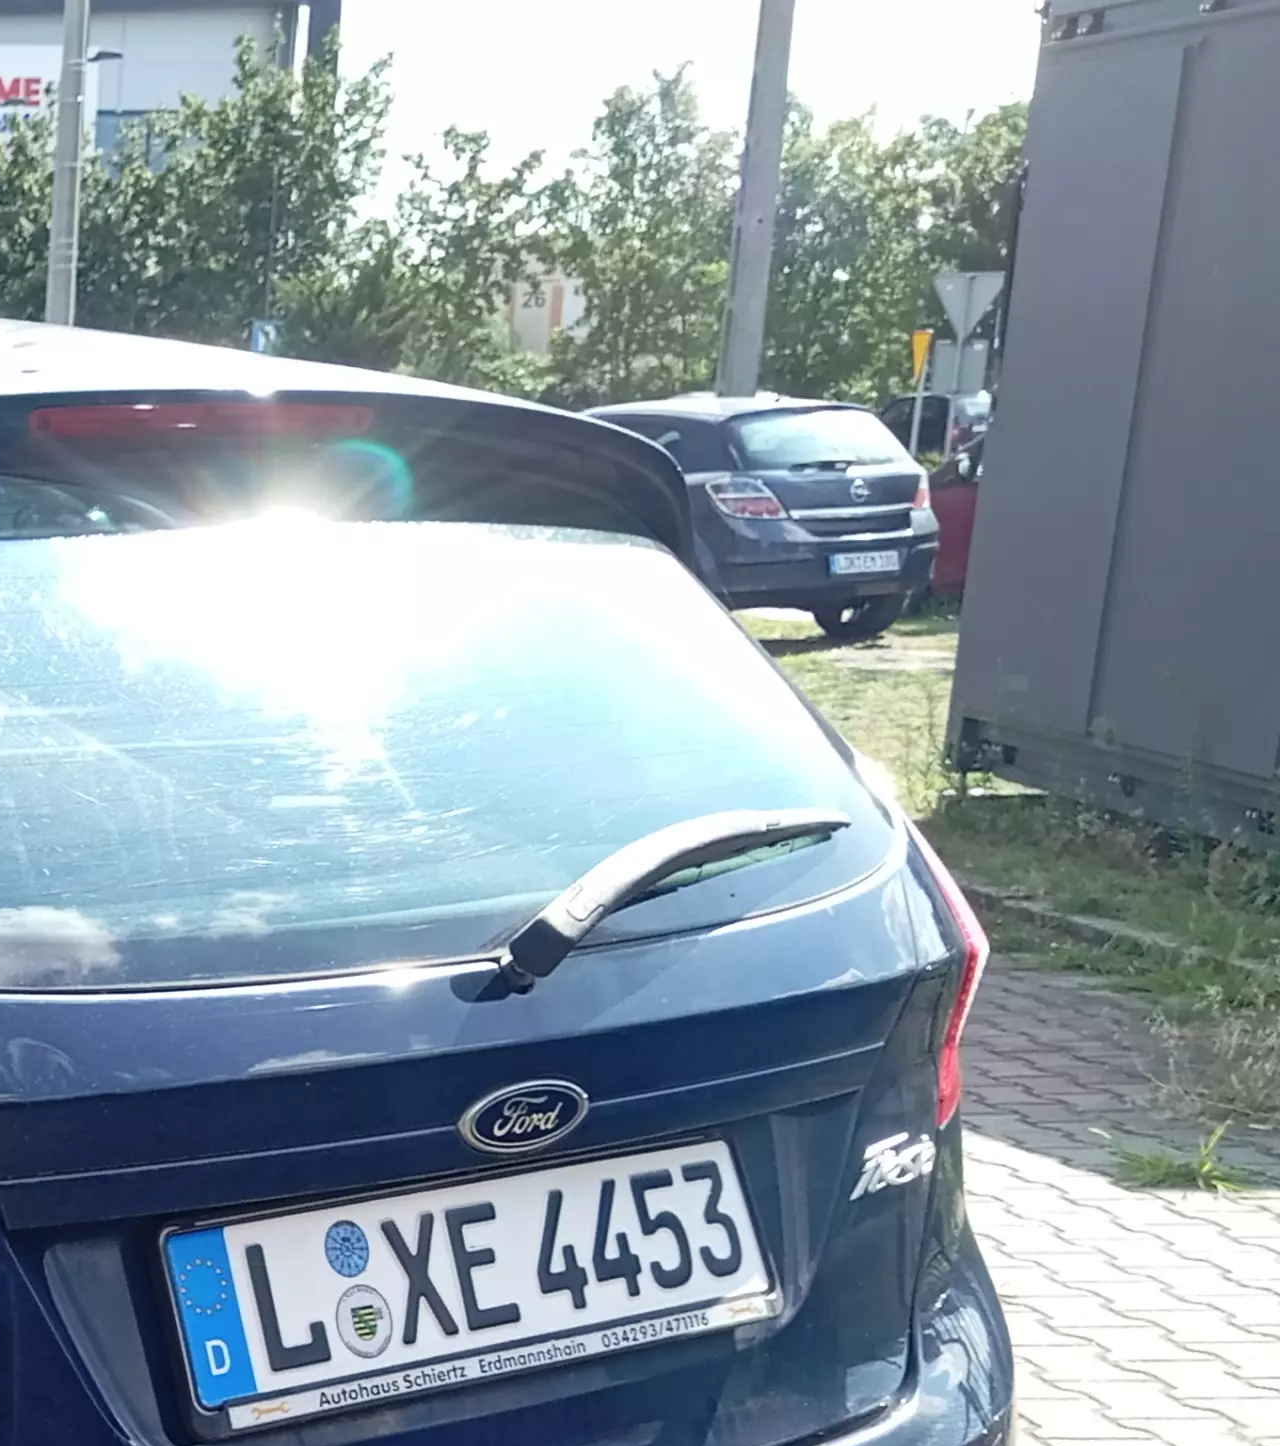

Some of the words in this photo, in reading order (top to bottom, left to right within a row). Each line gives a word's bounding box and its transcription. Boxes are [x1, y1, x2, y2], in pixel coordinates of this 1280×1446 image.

[493, 1095, 563, 1137] Ford
[244, 1242, 332, 1373] L
[381, 1200, 521, 1345] XE
[536, 1159, 743, 1310] 4453
[205, 1338, 232, 1376] D
[318, 1379, 401, 1408] Autohaus
[402, 1364, 468, 1389] Schiertz
[479, 1339, 587, 1374] Erdmannshain
[600, 1311, 710, 1349] 034293/471116
